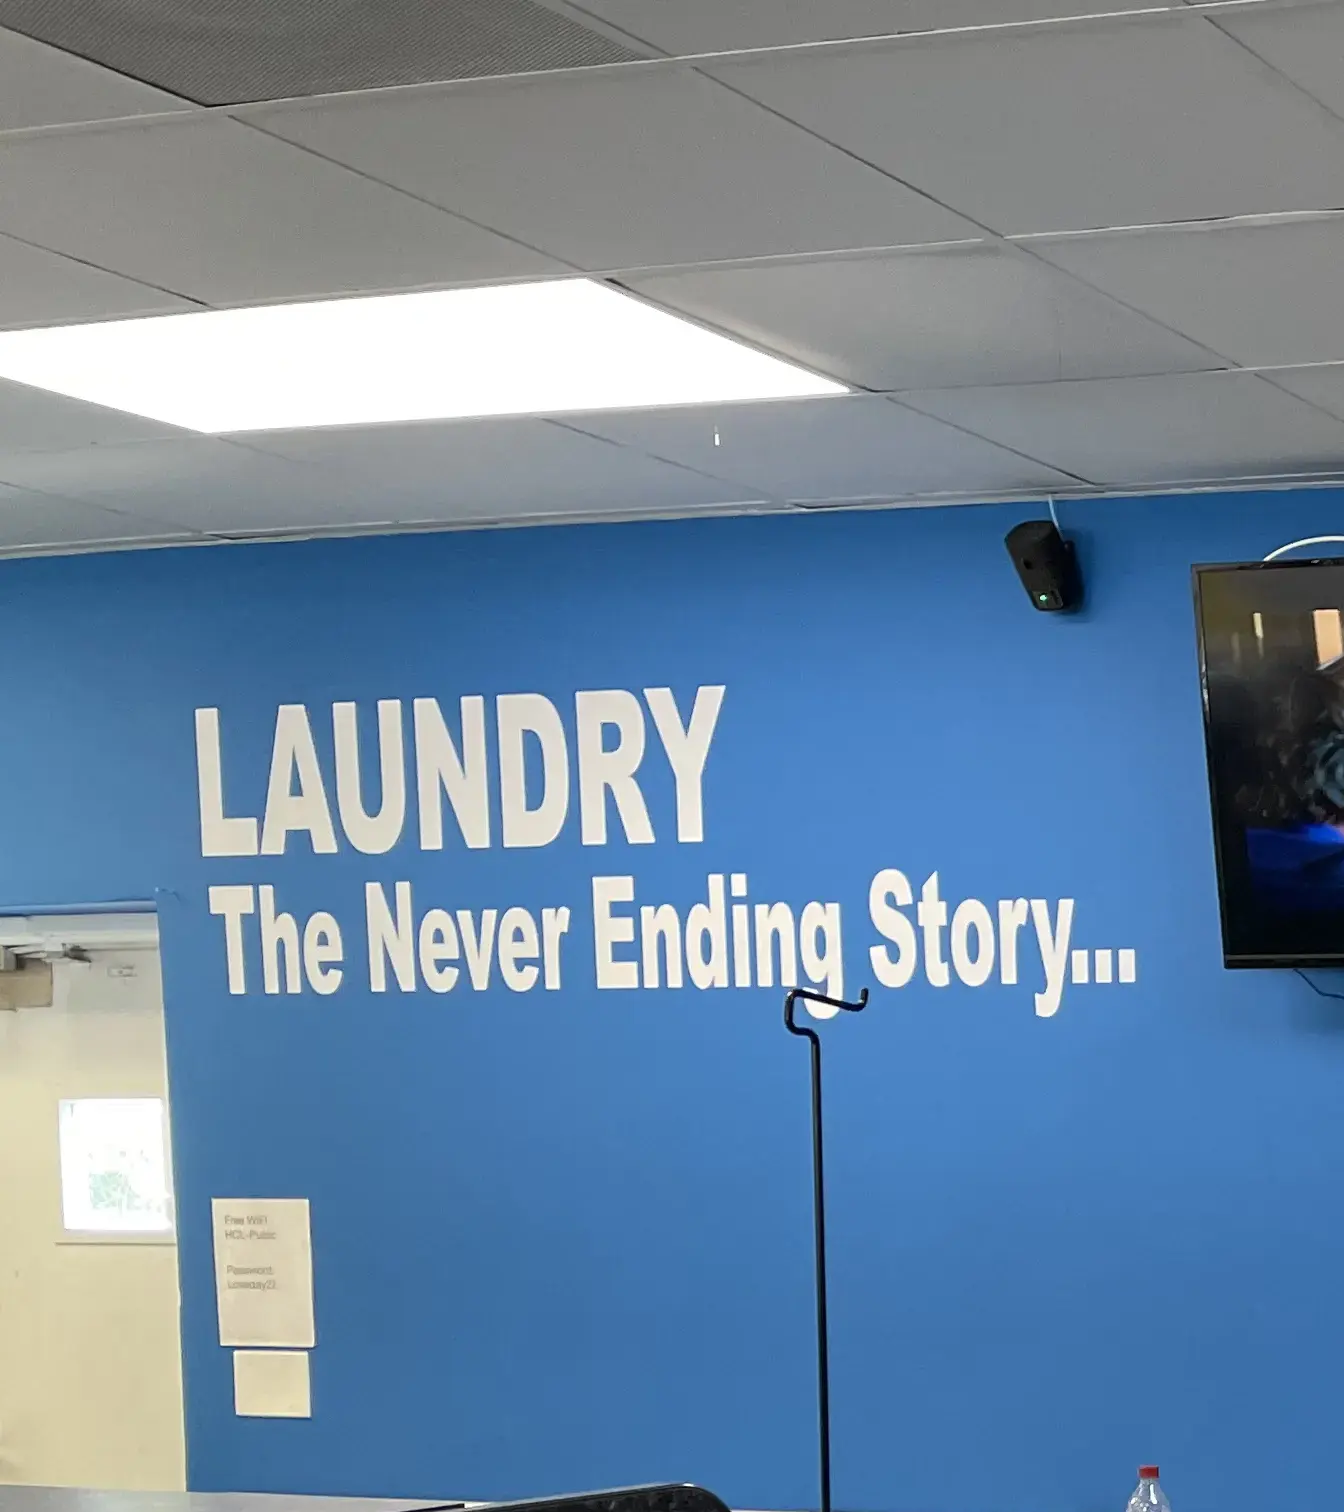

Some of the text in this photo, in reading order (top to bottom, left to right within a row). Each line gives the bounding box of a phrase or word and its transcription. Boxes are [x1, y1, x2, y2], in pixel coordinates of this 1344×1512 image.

[194, 684, 727, 858] LAUNDRY
[208, 868, 1136, 1019] The Never Ending Story...
